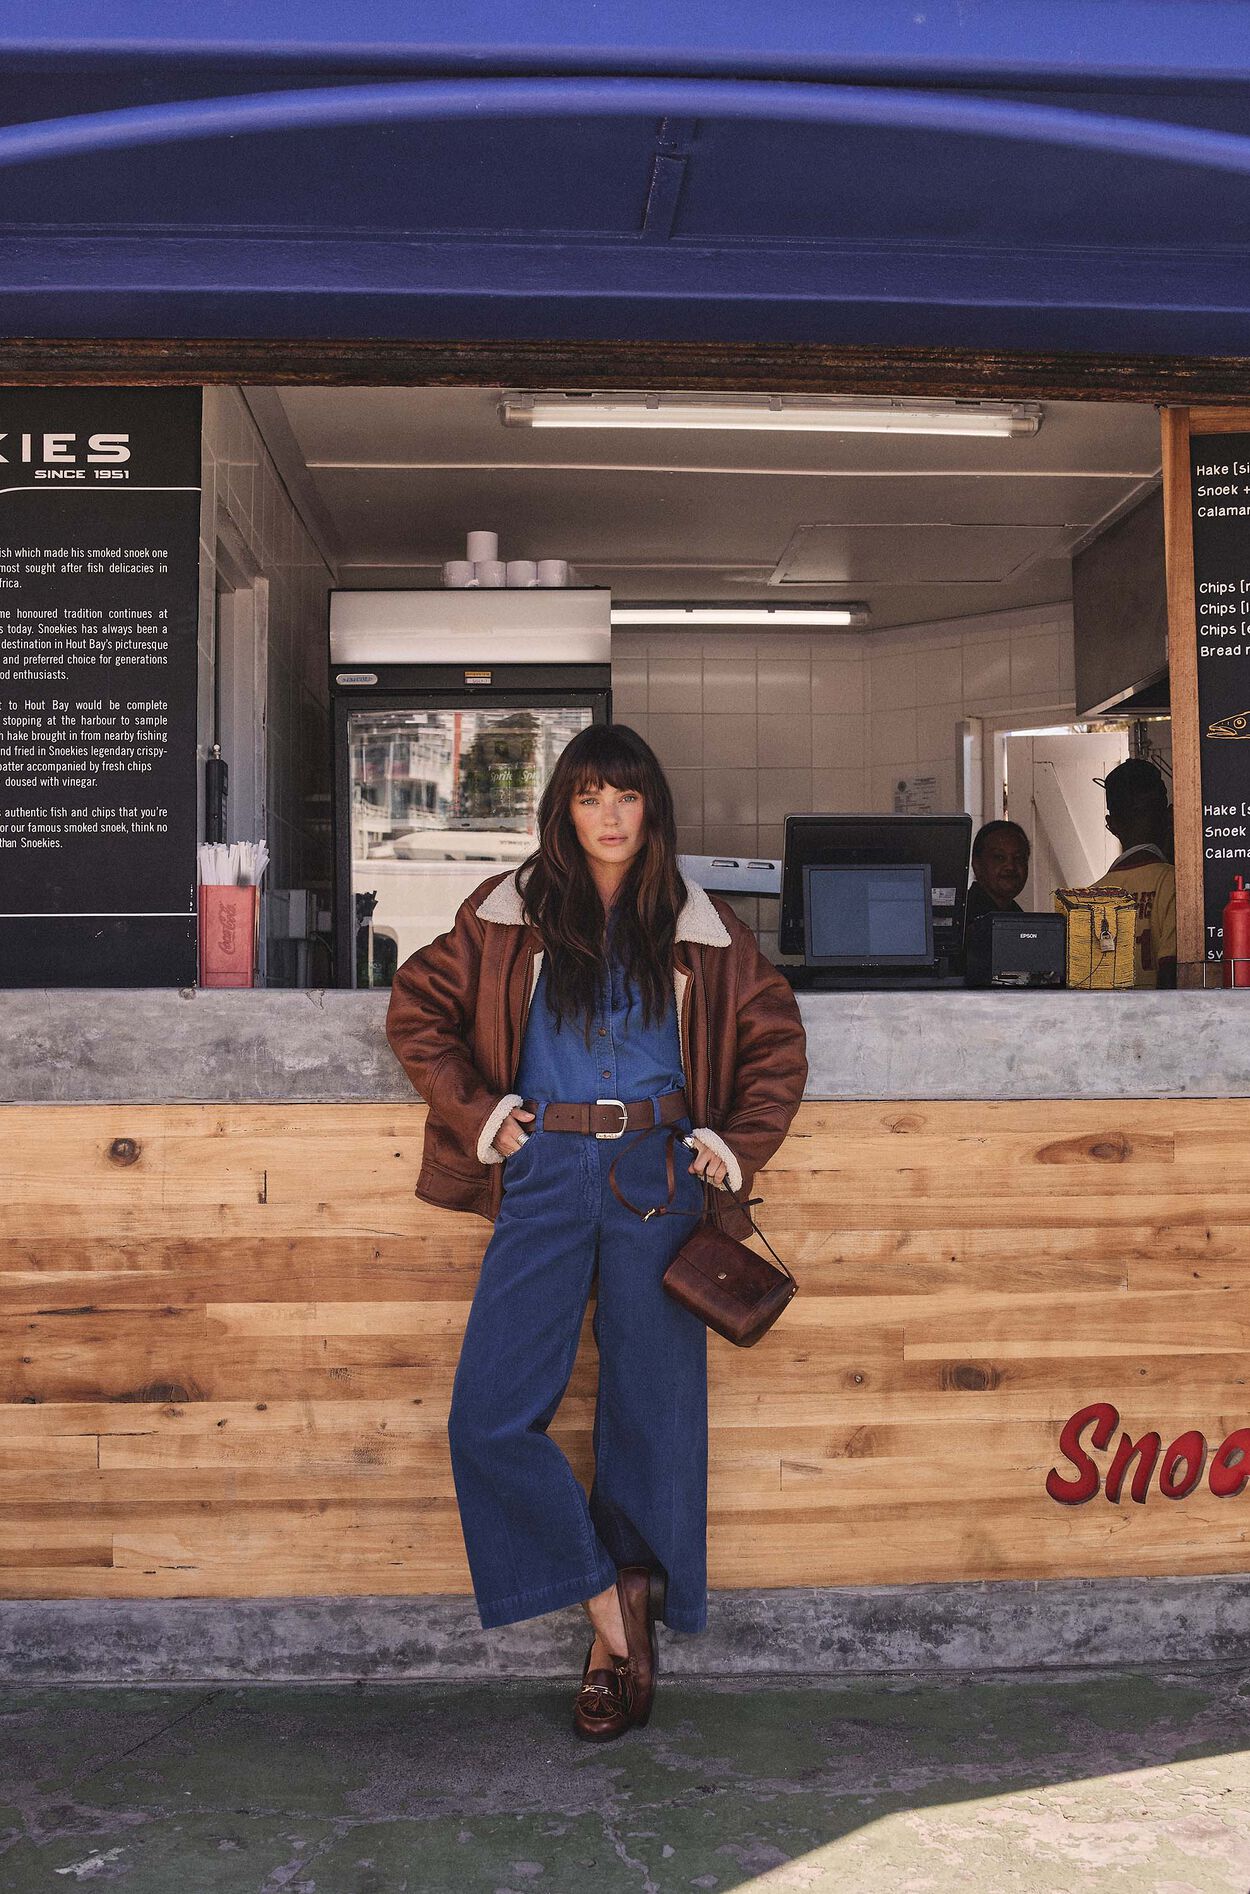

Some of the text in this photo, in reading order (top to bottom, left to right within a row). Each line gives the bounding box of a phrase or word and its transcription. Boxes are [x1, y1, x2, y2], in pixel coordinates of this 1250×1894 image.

[0, 434, 131, 463] IES
[34, 470, 130, 479] SINCE 1951
[1197, 465, 1229, 476] Hake
[1197, 485, 1239, 497] Snoek
[15, 547, 40, 557] which
[44, 548, 68, 557] made
[72, 548, 84, 557] his
[87, 547, 121, 557] smoked
[124, 548, 149, 558] snoek
[152, 550, 168, 558] one
[25, 563, 55, 575] sought
[61, 563, 82, 573] after
[87, 563, 103, 573] fish
[109, 563, 154, 573] delicacies
[160, 563, 167, 572] in
[1199, 581, 1236, 596] Chips
[17, 608, 57, 618] honoured
[64, 608, 102, 618] tradition
[109, 608, 152, 618] continues
[159, 609, 168, 618] at
[1200, 602, 1236, 617] Chips
[8, 624, 34, 635] today.
[38, 623, 77, 633] Snoekies
[82, 624, 98, 633] has
[102, 624, 132, 635] always
[137, 624, 157, 634] been
[162, 626, 167, 634] a
[1200, 623, 1237, 638] Chips
[1, 639, 168, 651] destination in Hout Bay's picturesque
[1201, 645, 1241, 657] Bread
[3, 654, 167, 666] and preferred choice for generations
[13, 669, 68, 679] enthusiasts.
[9, 700, 17, 710] to
[25, 700, 45, 710] Hout
[53, 700, 69, 712] Bay
[76, 700, 102, 711] would
[110, 700, 120, 710] be
[127, 700, 167, 711] complete
[3, 715, 167, 727] stopping at the harbour to sample
[7, 731, 28, 740] hake
[32, 731, 66, 742] brought
[70, 730, 77, 740] in
[80, 730, 101, 740] from
[105, 730, 134, 742] nearby
[137, 730, 167, 742] fishing
[14, 746, 34, 756] fried
[38, 746, 46, 755] in
[49, 746, 88, 756] Snoekies
[91, 746, 134, 758] legendary
[137, 746, 167, 757] crispy-
[27, 761, 86, 773] accompanied
[90, 761, 99, 773] by
[102, 761, 124, 771] fresh
[128, 761, 151, 773] chips
[5, 776, 97, 788] doused with vinegar.
[5, 807, 47, 817] authentic
[50, 807, 67, 817] fish
[71, 807, 87, 817] and
[92, 807, 115, 819] chips
[119, 807, 137, 817] that
[141, 807, 167, 819] you're
[1204, 805, 1237, 816] Hake
[28, 822, 61, 832] famous
[64, 822, 97, 832] smoked
[101, 822, 128, 833] snoek,
[131, 822, 154, 832] think
[157, 824, 167, 832] no
[1205, 826, 1246, 837] Snoek
[21, 837, 62, 848] Snoekies.
